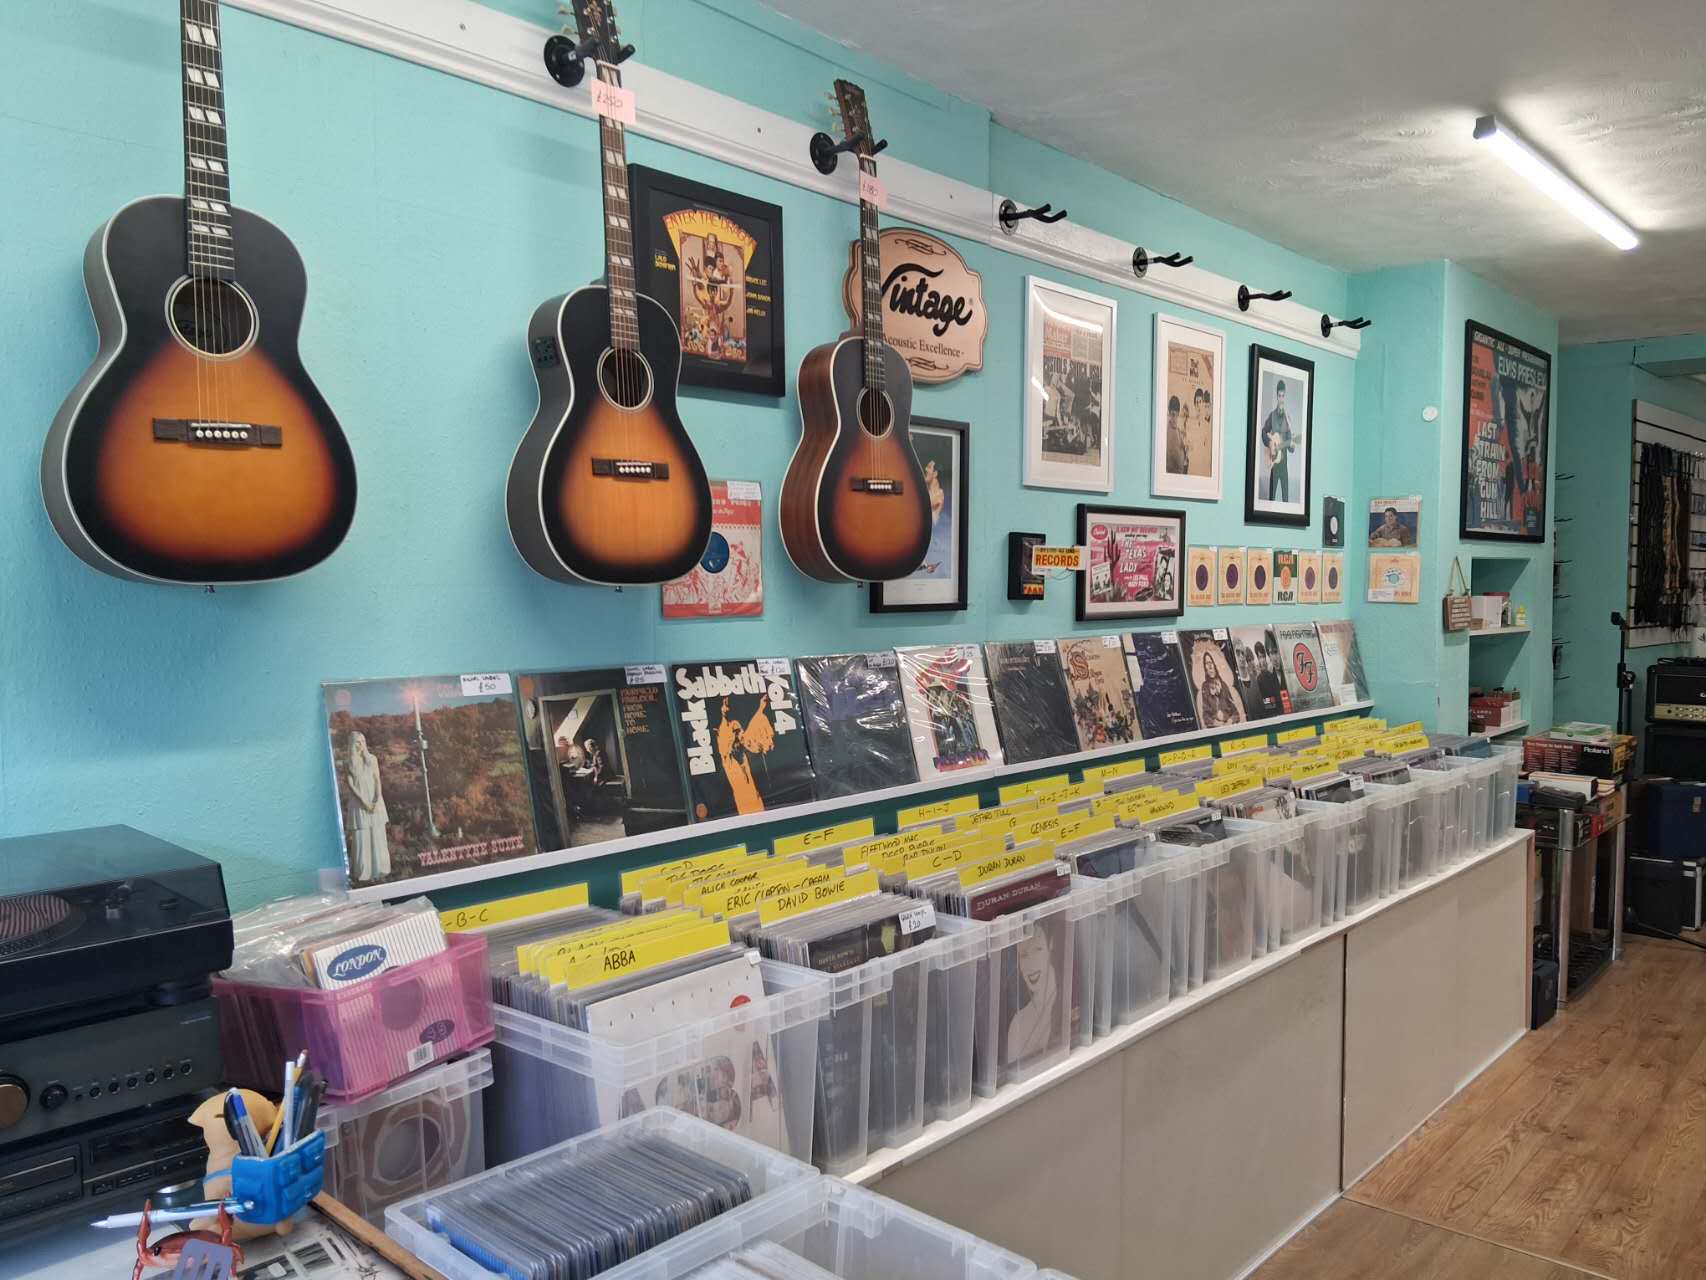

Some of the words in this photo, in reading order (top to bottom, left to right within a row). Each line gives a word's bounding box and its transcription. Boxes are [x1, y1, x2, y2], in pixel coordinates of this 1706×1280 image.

[919, 339, 961, 358] Excellence
[1498, 356, 1517, 379] ELVIS
[1477, 421, 1498, 440] LAST
[1035, 554, 1079, 567] RECORDS
[1277, 591, 1294, 601] RCA
[675, 663, 767, 700] Sabbath
[774, 711, 797, 735] 4
[681, 699, 717, 776] Black
[1583, 746, 1610, 755] Roland
[1030, 818, 1060, 835] GENESIS
[417, 843, 489, 867] VALENTYNE
[491, 836, 525, 853] SUITE
[701, 882, 726, 895] ALICE
[777, 892, 808, 911] DAVID
[815, 881, 845, 900] BOWIE
[976, 892, 1008, 911] DURAN
[1011, 882, 1041, 897] DURAN
[727, 892, 751, 911] ERIC
[332, 948, 384, 977] LONDON
[603, 949, 637, 973] ABBA
